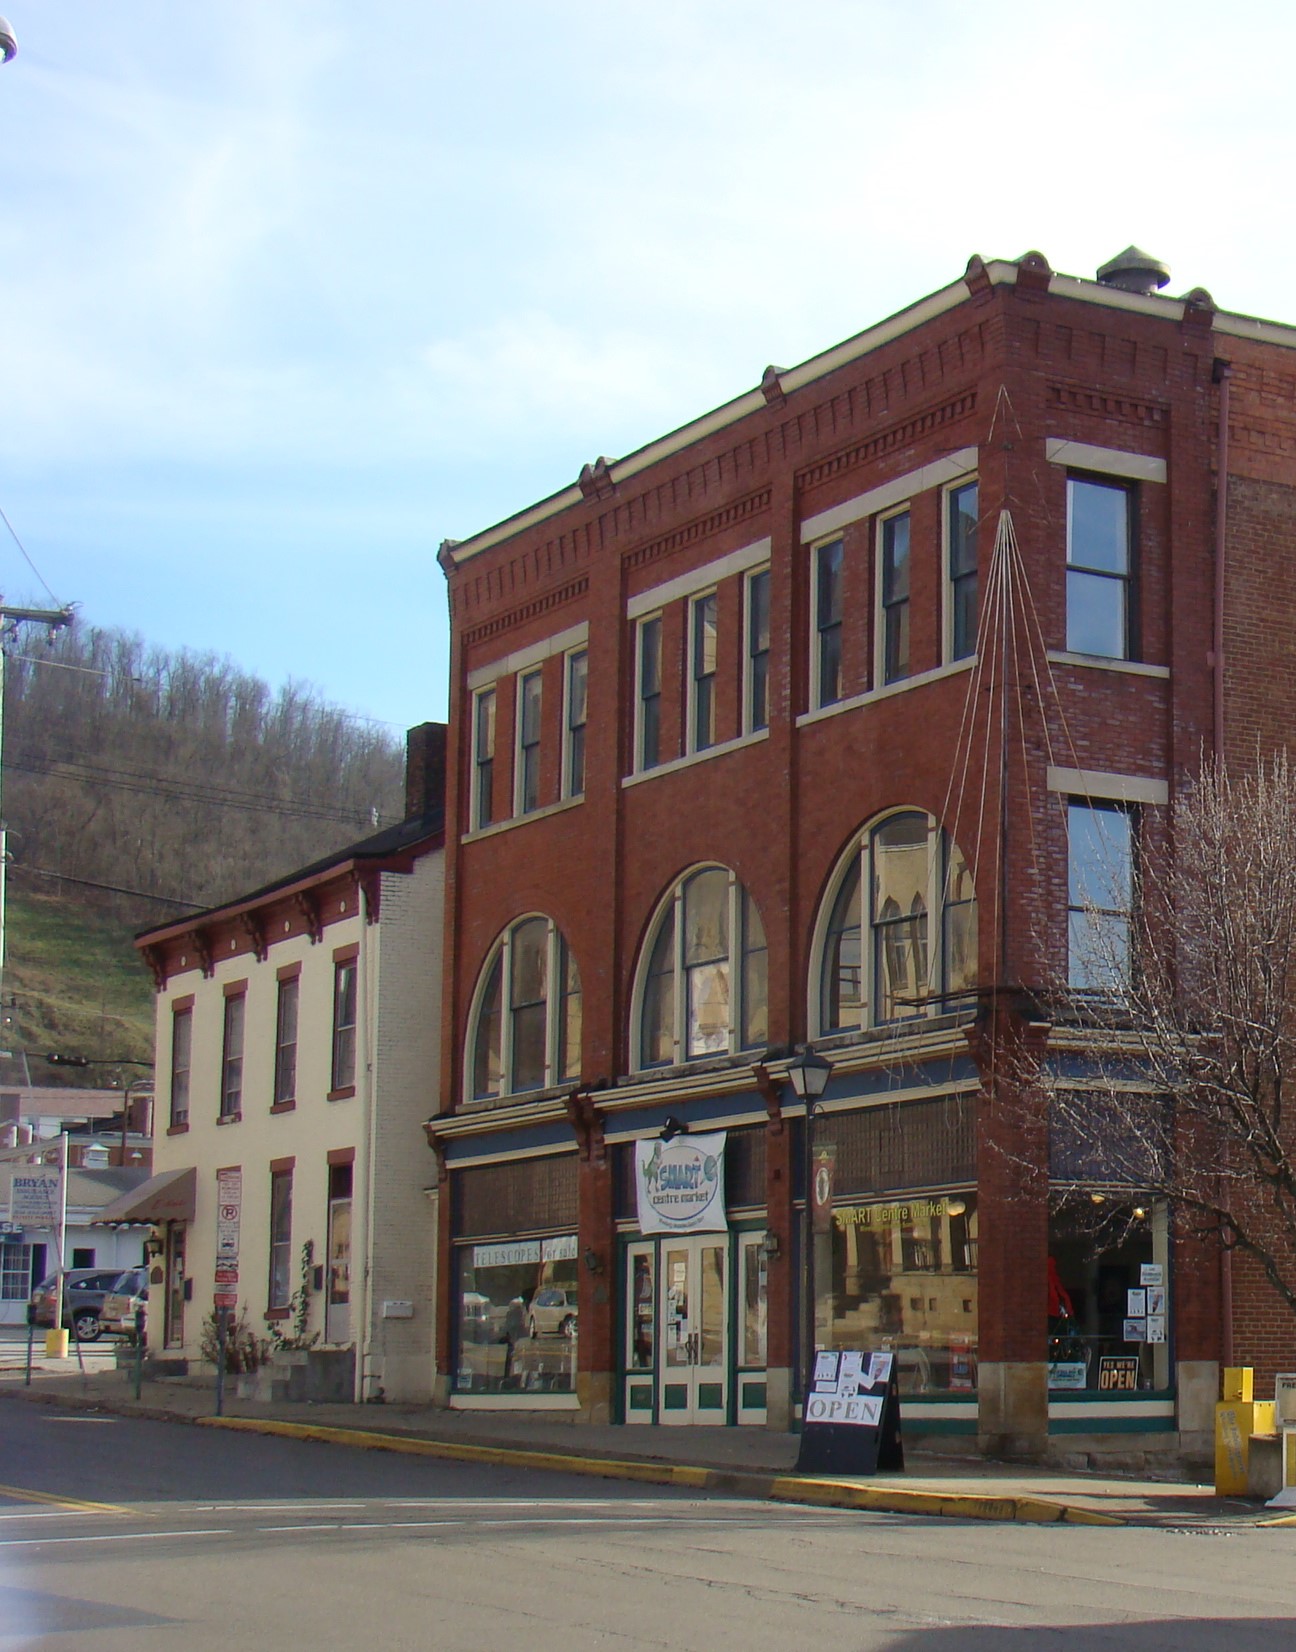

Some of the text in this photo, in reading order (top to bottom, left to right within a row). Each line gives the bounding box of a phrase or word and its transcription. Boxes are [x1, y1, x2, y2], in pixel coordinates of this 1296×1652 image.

[14, 1178, 58, 1188] BRYAN
[660, 1164, 701, 1191] SMART
[653, 1191, 708, 1204] centre market
[836, 1201, 948, 1225] SMART Centre Market
[476, 1247, 539, 1266] TELESCOPES
[1103, 1361, 1115, 1369] YES
[1101, 1370, 1134, 1389] OPEN
[809, 1399, 878, 1421] OPEN
